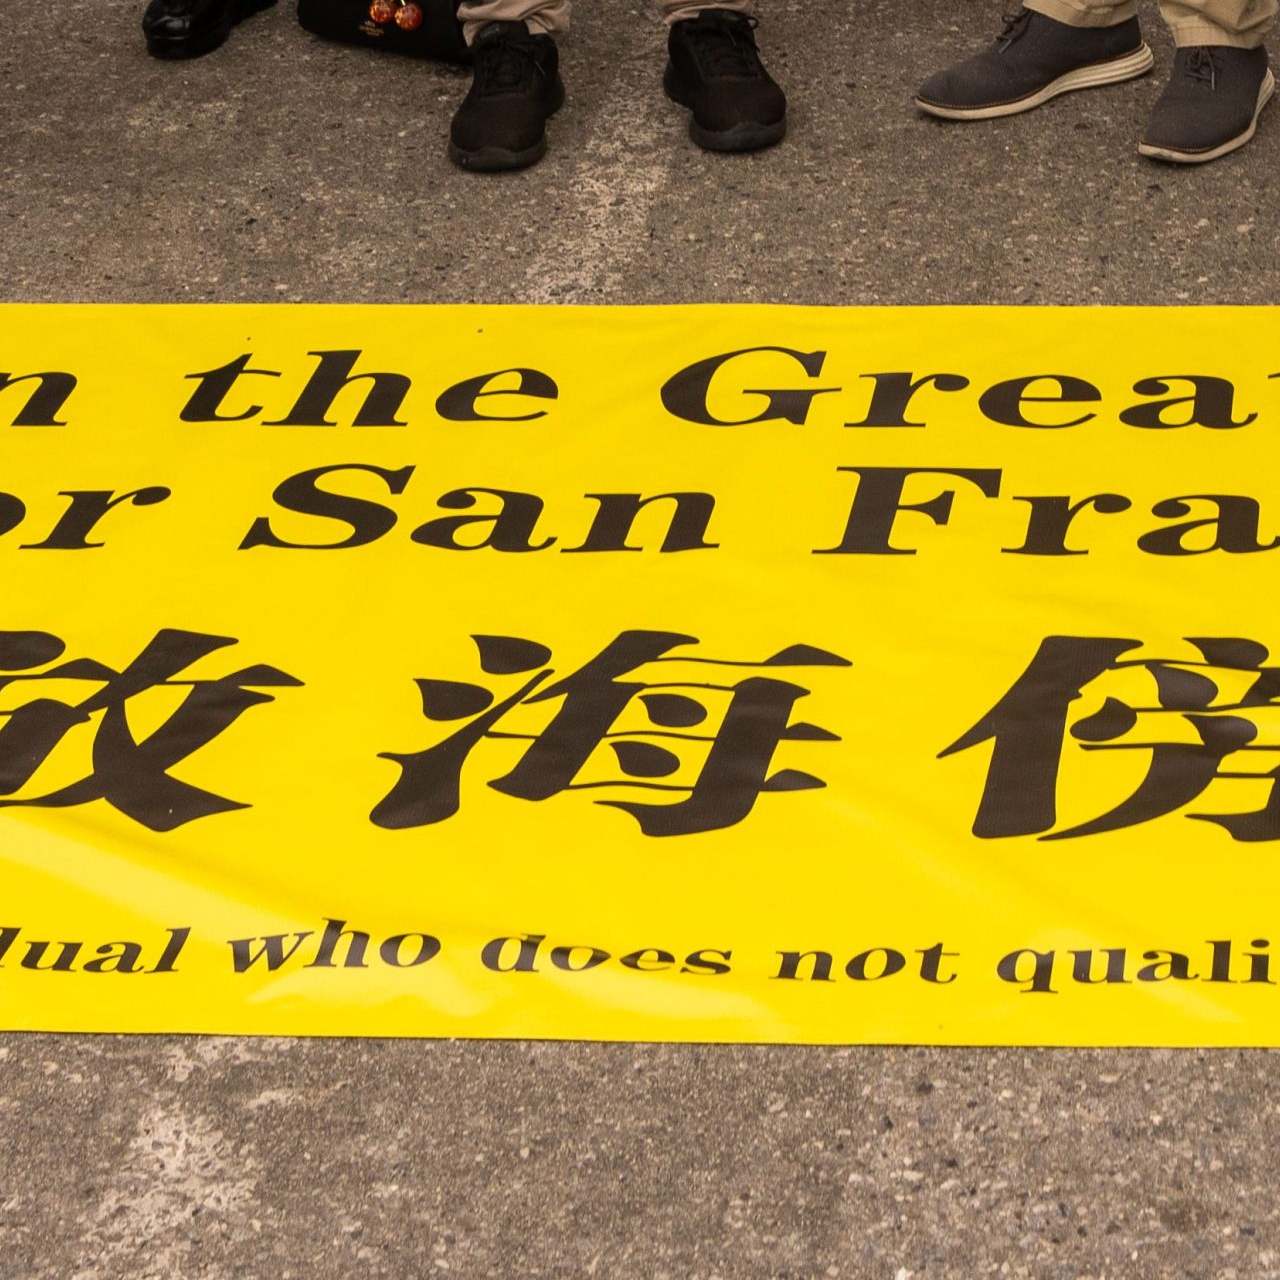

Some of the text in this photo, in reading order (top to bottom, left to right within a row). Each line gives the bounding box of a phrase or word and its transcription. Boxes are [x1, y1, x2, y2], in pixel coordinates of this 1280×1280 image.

[180, 350, 558, 427] the
[238, 464, 720, 553] San
[227, 919, 441, 973] who
[481, 935, 732, 974] does
[775, 943, 959, 983] not
